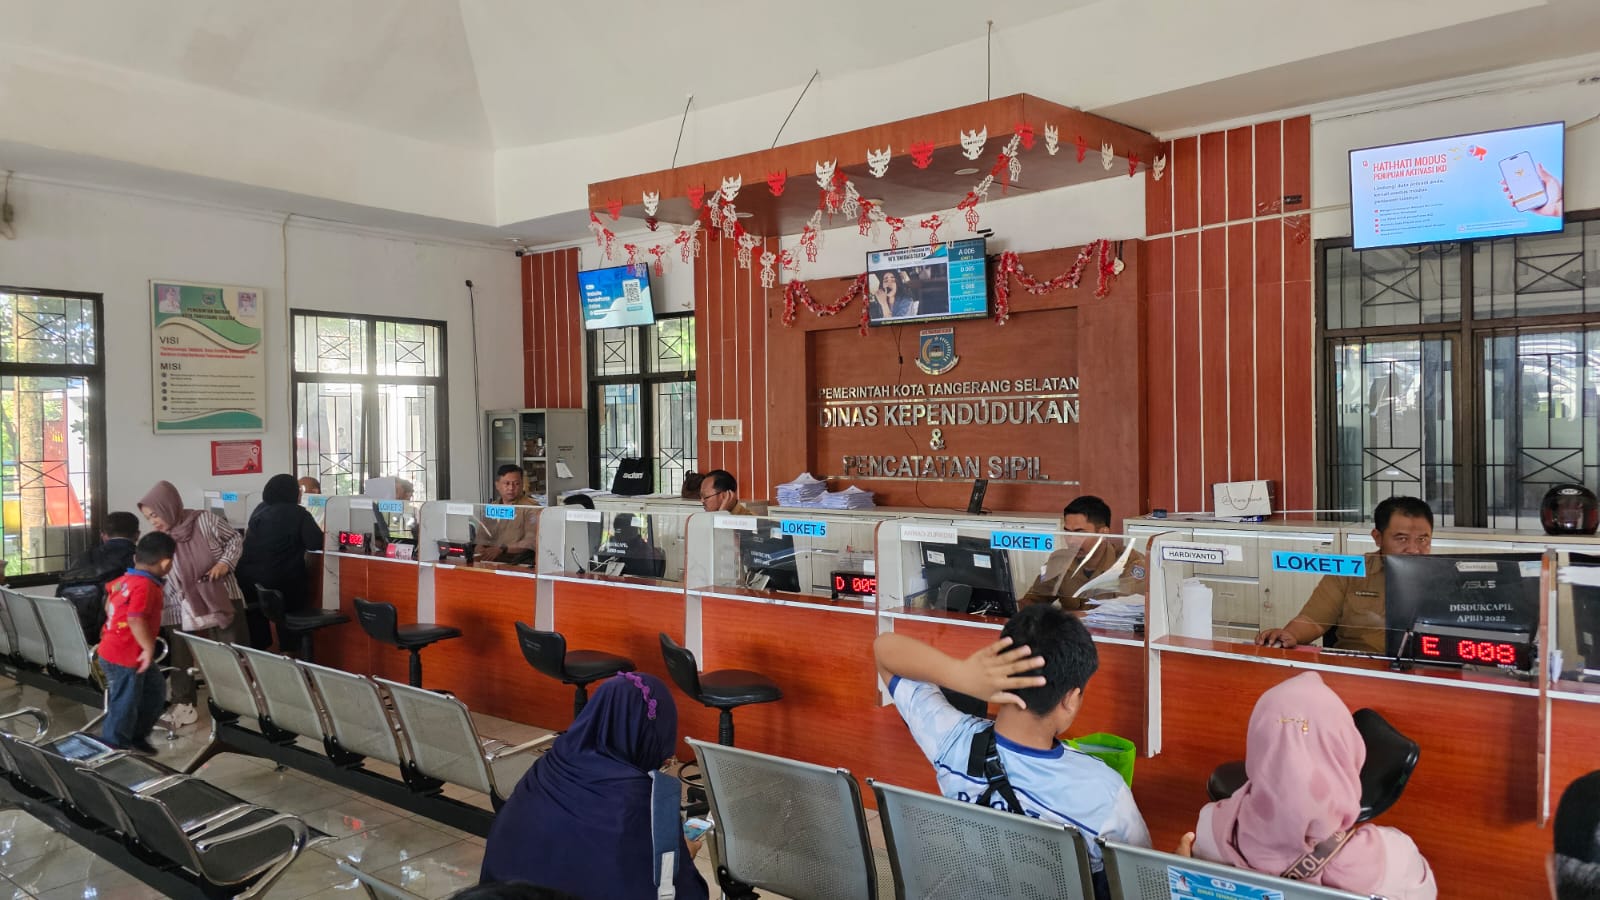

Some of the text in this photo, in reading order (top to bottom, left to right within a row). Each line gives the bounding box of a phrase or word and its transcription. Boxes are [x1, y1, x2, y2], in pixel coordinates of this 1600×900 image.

[1373, 153, 1447, 172] HATI-HATI MODUS
[1405, 166, 1434, 177] AKTIVASI
[160, 336, 179, 344] VISI
[160, 362, 182, 370] MISI
[819, 376, 1079, 399] PEMERINTAH KOTA TANGERANG SELATAN
[819, 399, 1080, 428] DINAS KEPENDUDUKAN
[929, 428, 945, 450] &
[843, 455, 1049, 480] PENCATATAN SIPIL
[379, 502, 398, 512] LOKET
[486, 506, 509, 518] LOKET
[782, 521, 826, 536] LOKET 5
[341, 532, 346, 544] C
[993, 534, 1053, 550] LOKET 6
[1168, 550, 1217, 560] HARDIYANTO
[1276, 554, 1362, 574] LOKET 7
[836, 576, 844, 590] D
[1462, 580, 1496, 589] ASUS
[1450, 603, 1514, 612] DISDUKCAPIL
[1457, 614, 1484, 623] APBD
[1422, 636, 1517, 664] E 008
